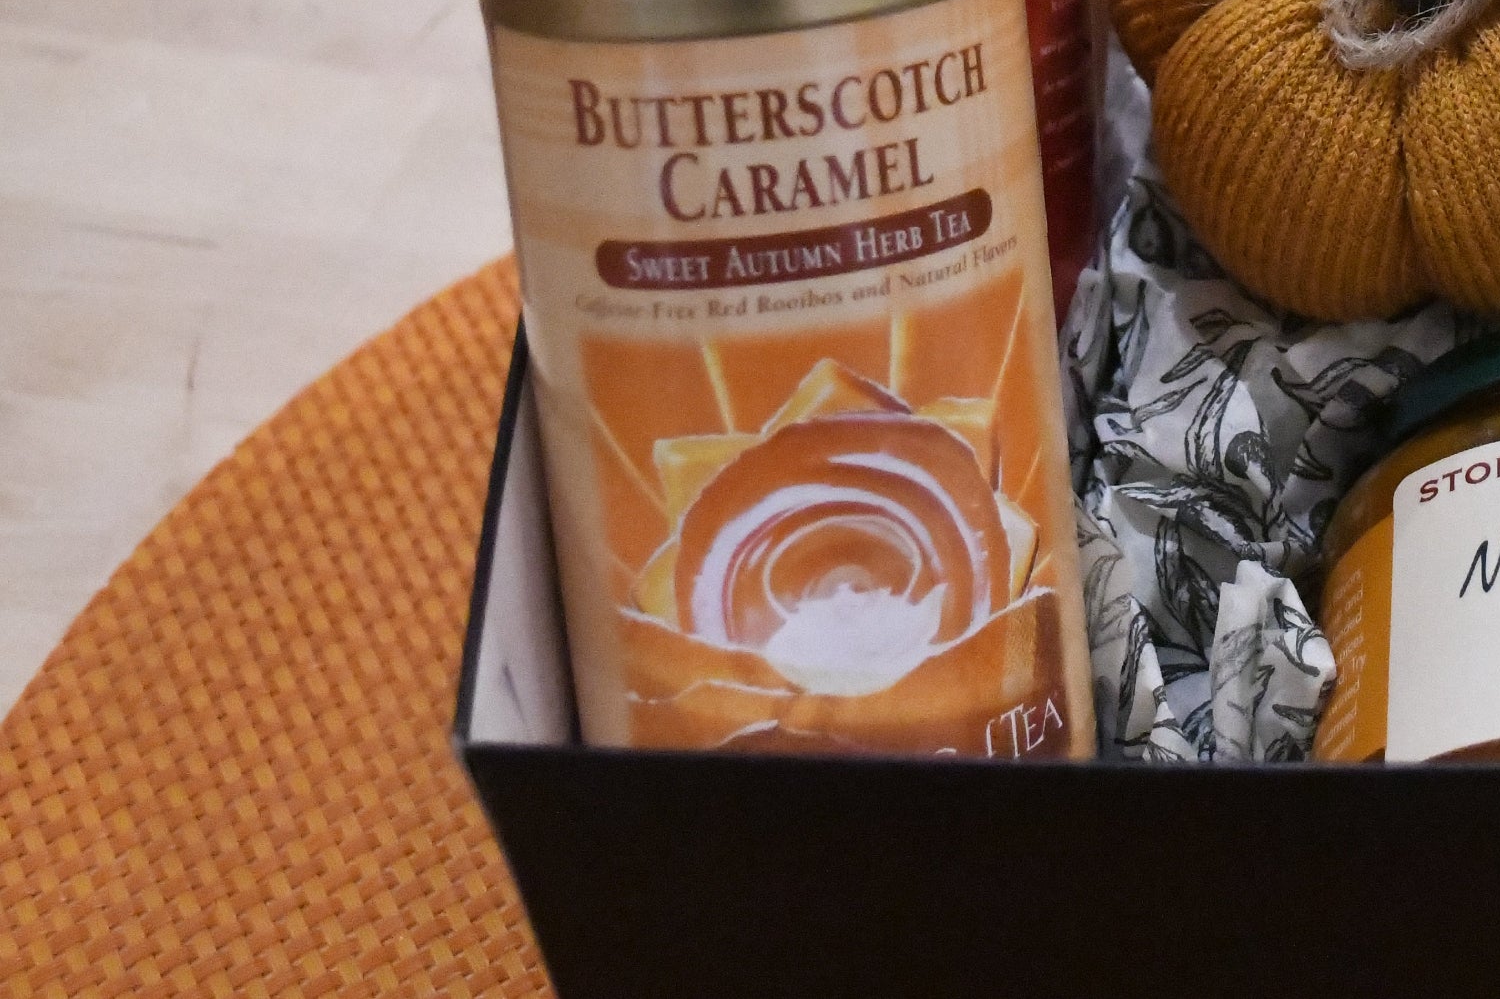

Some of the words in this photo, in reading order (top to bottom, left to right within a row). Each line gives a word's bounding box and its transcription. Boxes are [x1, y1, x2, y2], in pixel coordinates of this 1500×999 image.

[567, 42, 988, 151] BUTTERSCOTCH
[659, 137, 935, 223] CARAMEL
[625, 248, 711, 283] SWEET
[725, 240, 842, 279] AUTUMN
[854, 224, 924, 263] HERB
[929, 209, 973, 249] TEA
[706, 294, 749, 318] Red
[757, 286, 844, 314] Rooibos
[851, 277, 892, 300] and
[901, 258, 969, 292] Natural
[973, 233, 1019, 267] Flavors
[999, 697, 1064, 760] TEA
